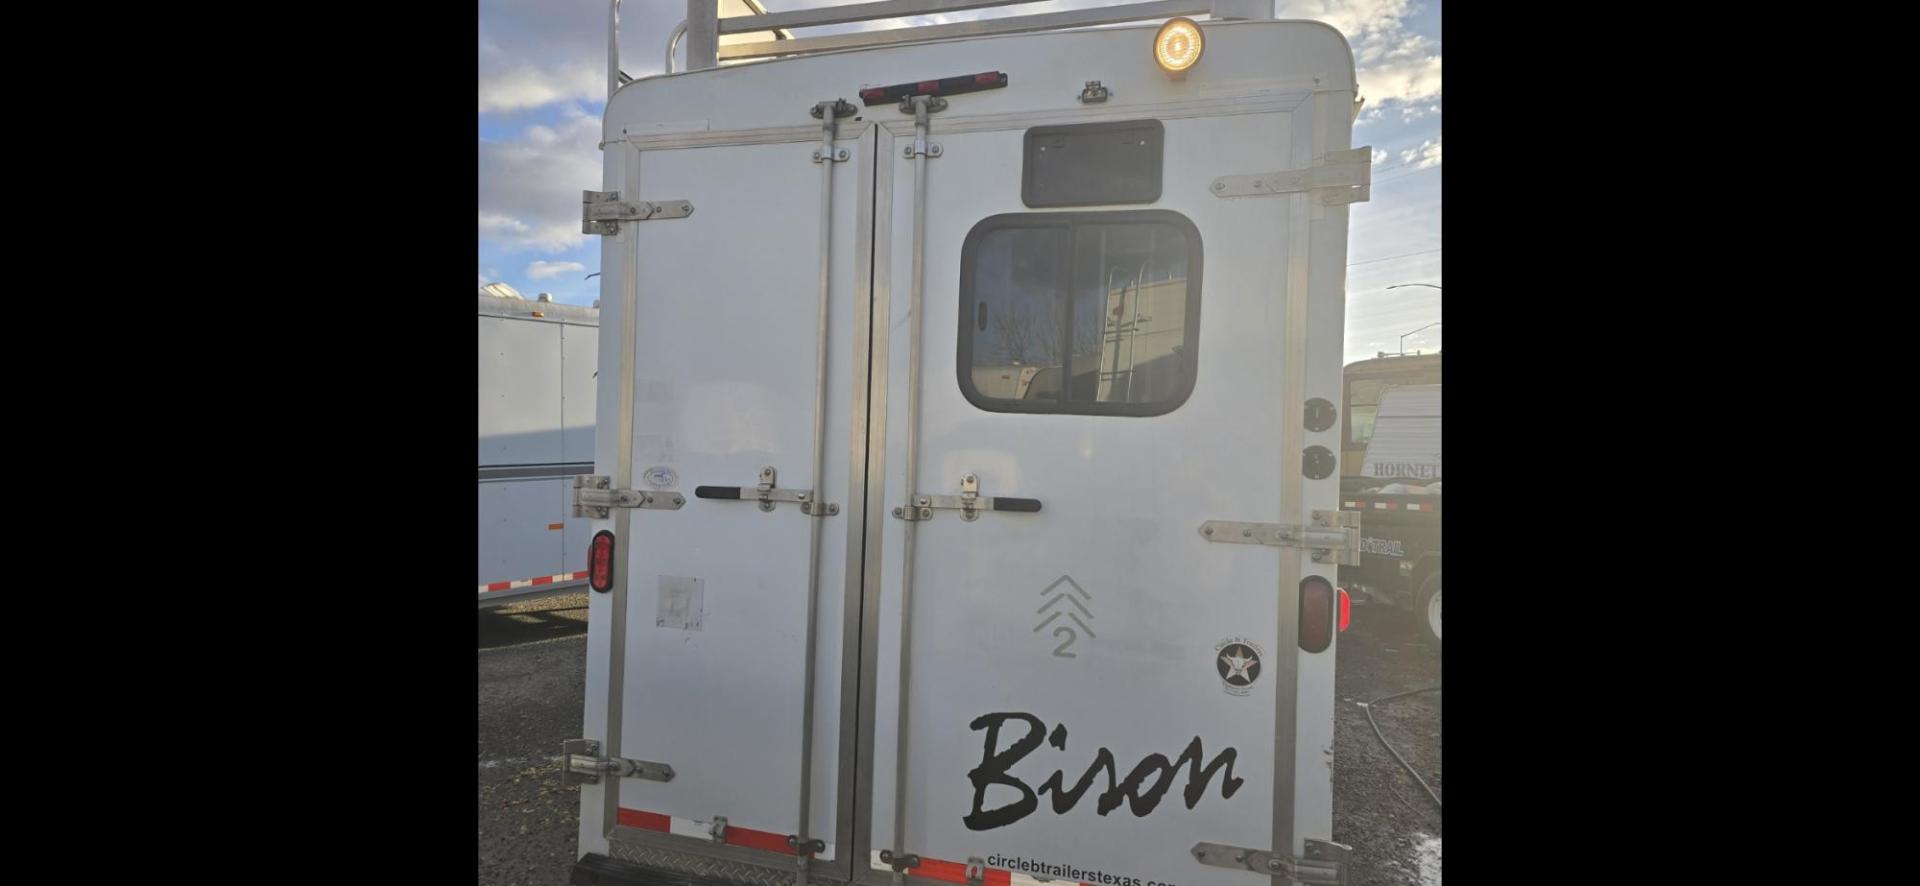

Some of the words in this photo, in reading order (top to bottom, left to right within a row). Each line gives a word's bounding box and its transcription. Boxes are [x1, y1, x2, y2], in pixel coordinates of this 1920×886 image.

[1374, 463, 1440, 477] HORNET
[1053, 626, 1077, 659] 2
[962, 711, 1245, 831] Bison
